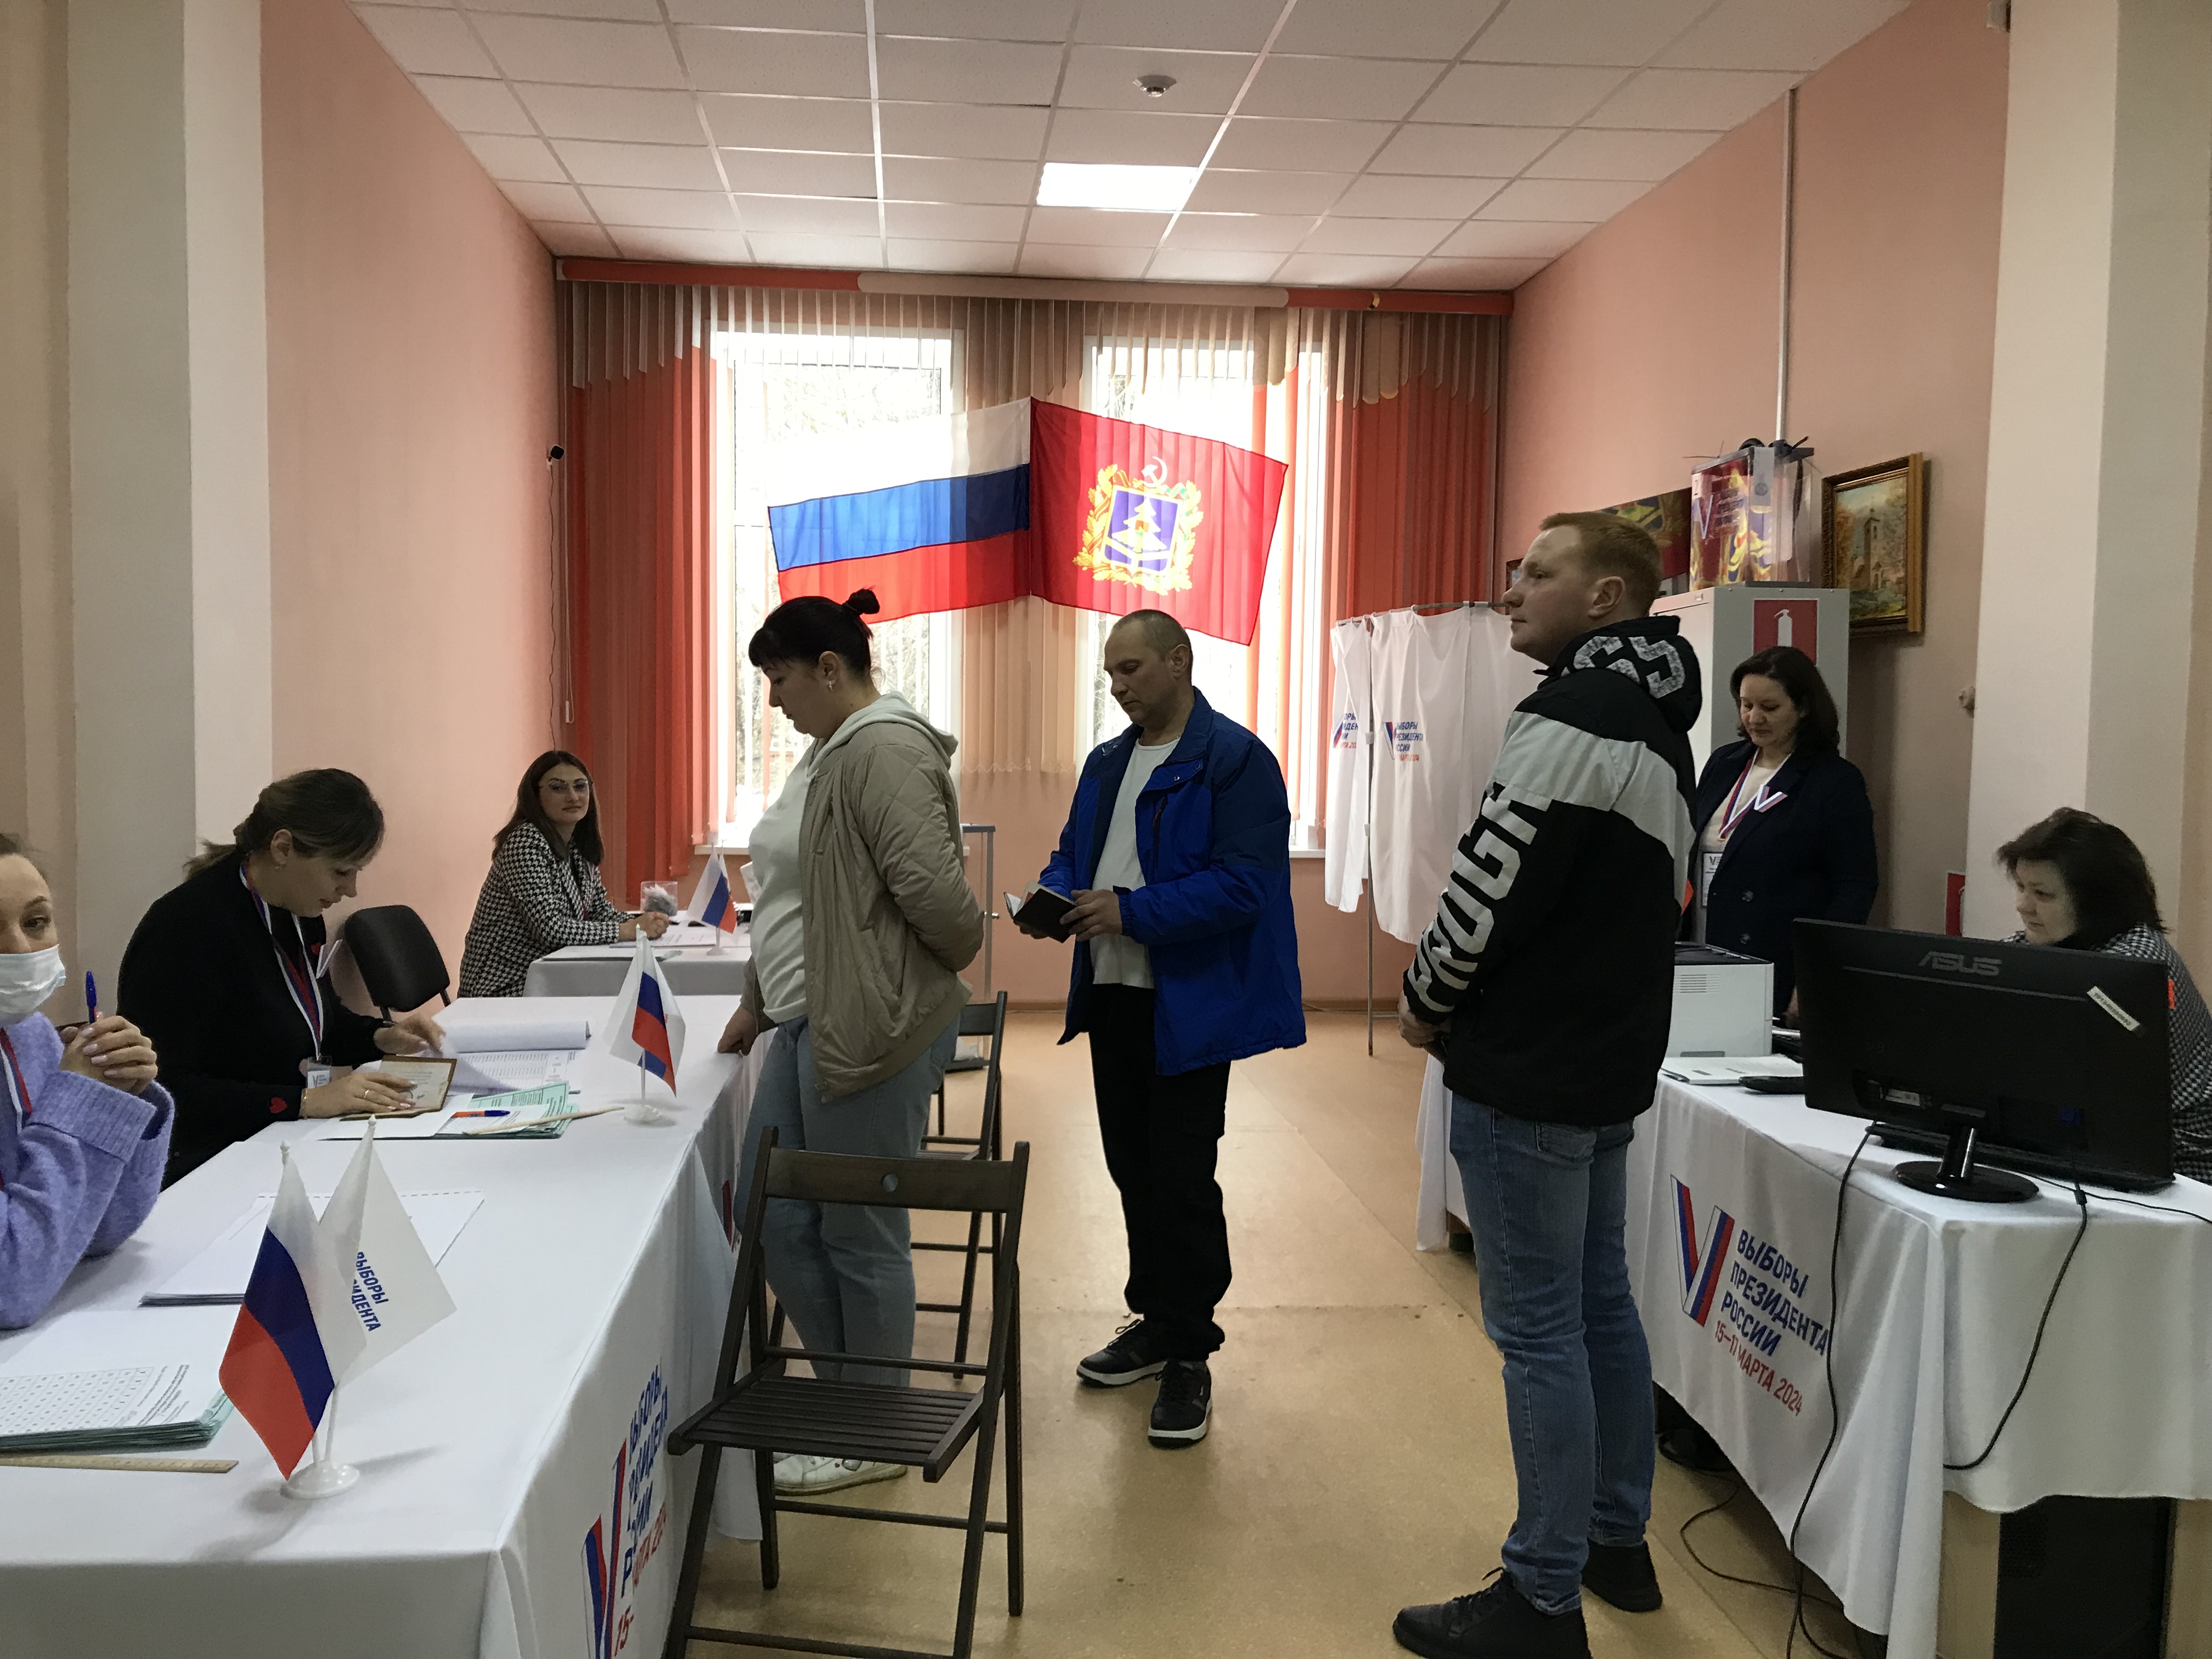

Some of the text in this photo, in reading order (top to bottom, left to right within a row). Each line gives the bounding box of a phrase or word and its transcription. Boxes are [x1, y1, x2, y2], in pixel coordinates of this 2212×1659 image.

[1918, 951, 2002, 976] ASUS
[1736, 1228, 1809, 1299] ВЫБОРЫ
[351, 1279, 381, 1332] ИДЕНТА
[1720, 1290, 1782, 1357] РОССИИ
[1729, 1260, 1831, 1357] ПРЕЗИДЕНТА
[1736, 1348, 1777, 1393] МАРТА
[1772, 1377, 1804, 1417] 2024
